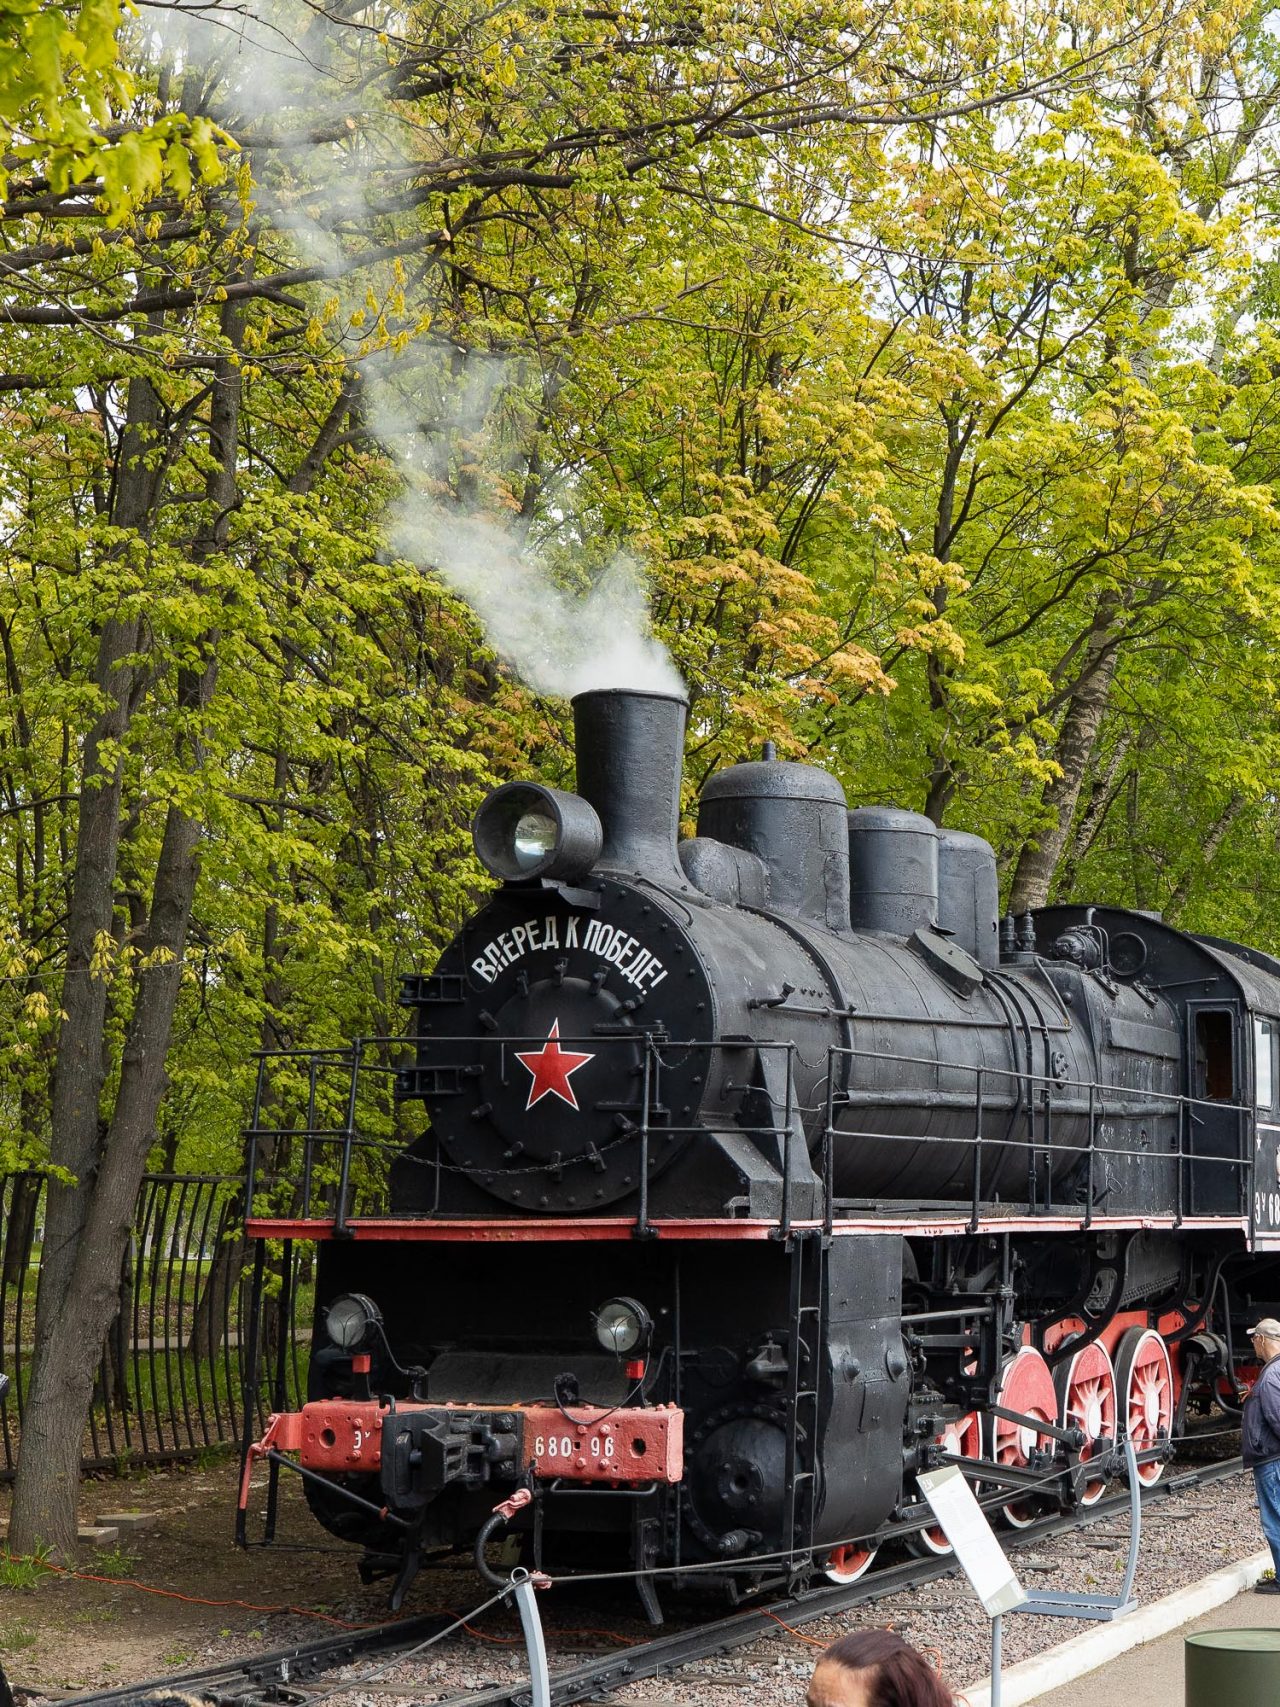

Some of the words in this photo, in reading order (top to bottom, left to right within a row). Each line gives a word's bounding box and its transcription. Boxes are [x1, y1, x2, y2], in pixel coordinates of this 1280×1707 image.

[471, 915, 560, 984] ВПЕРЕД
[565, 916, 580, 948] К
[583, 919, 669, 995] ПОБЕДЕ!
[535, 1436, 572, 1458] 680
[590, 1436, 614, 1457] 96
